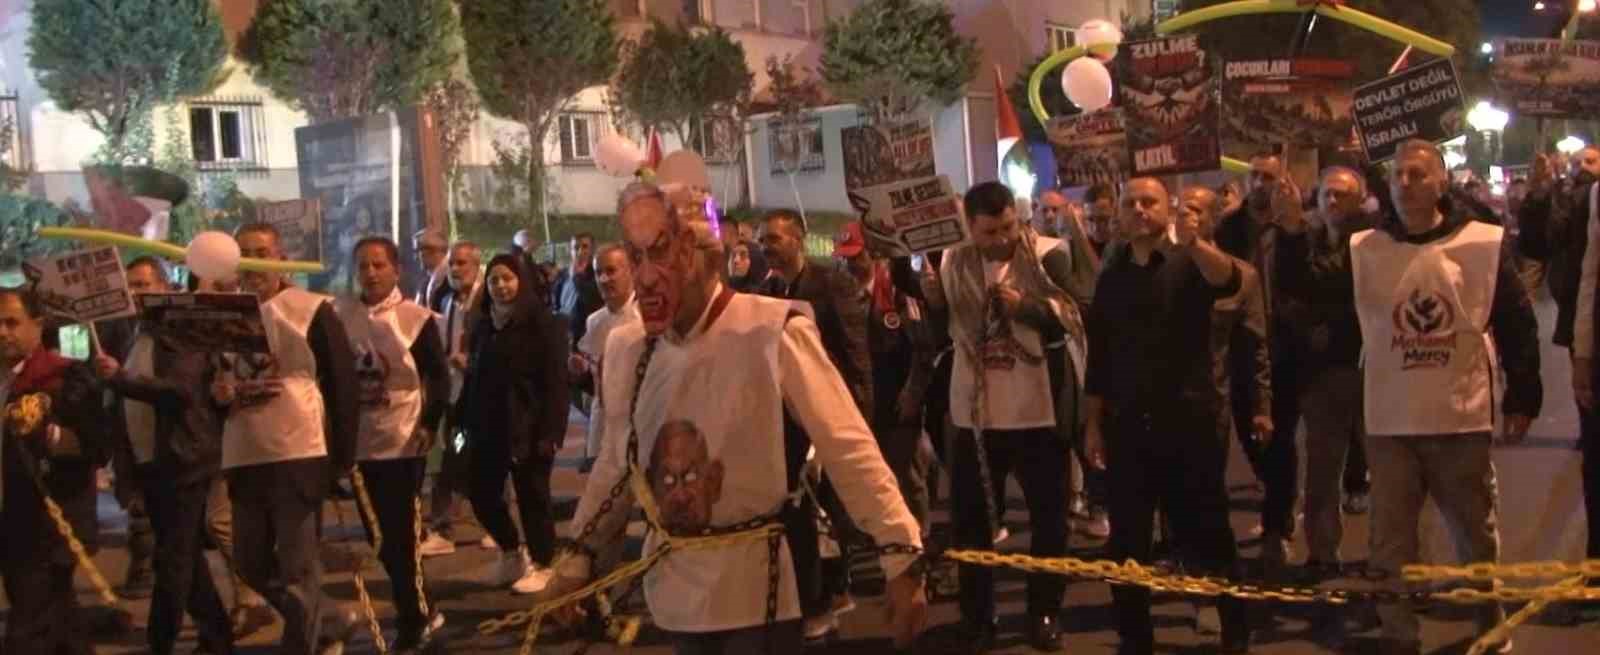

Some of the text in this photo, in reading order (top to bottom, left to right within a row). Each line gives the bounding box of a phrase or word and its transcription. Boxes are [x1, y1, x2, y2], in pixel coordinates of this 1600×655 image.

[1129, 38, 1197, 59] ZULME
[1225, 59, 1290, 79] ÇOCUKLARI
[1355, 67, 1452, 111] DEVLET DEĞİL
[1360, 83, 1458, 127] TERÖR ÖRGÜTÜ
[1403, 349, 1450, 367] Mercy
